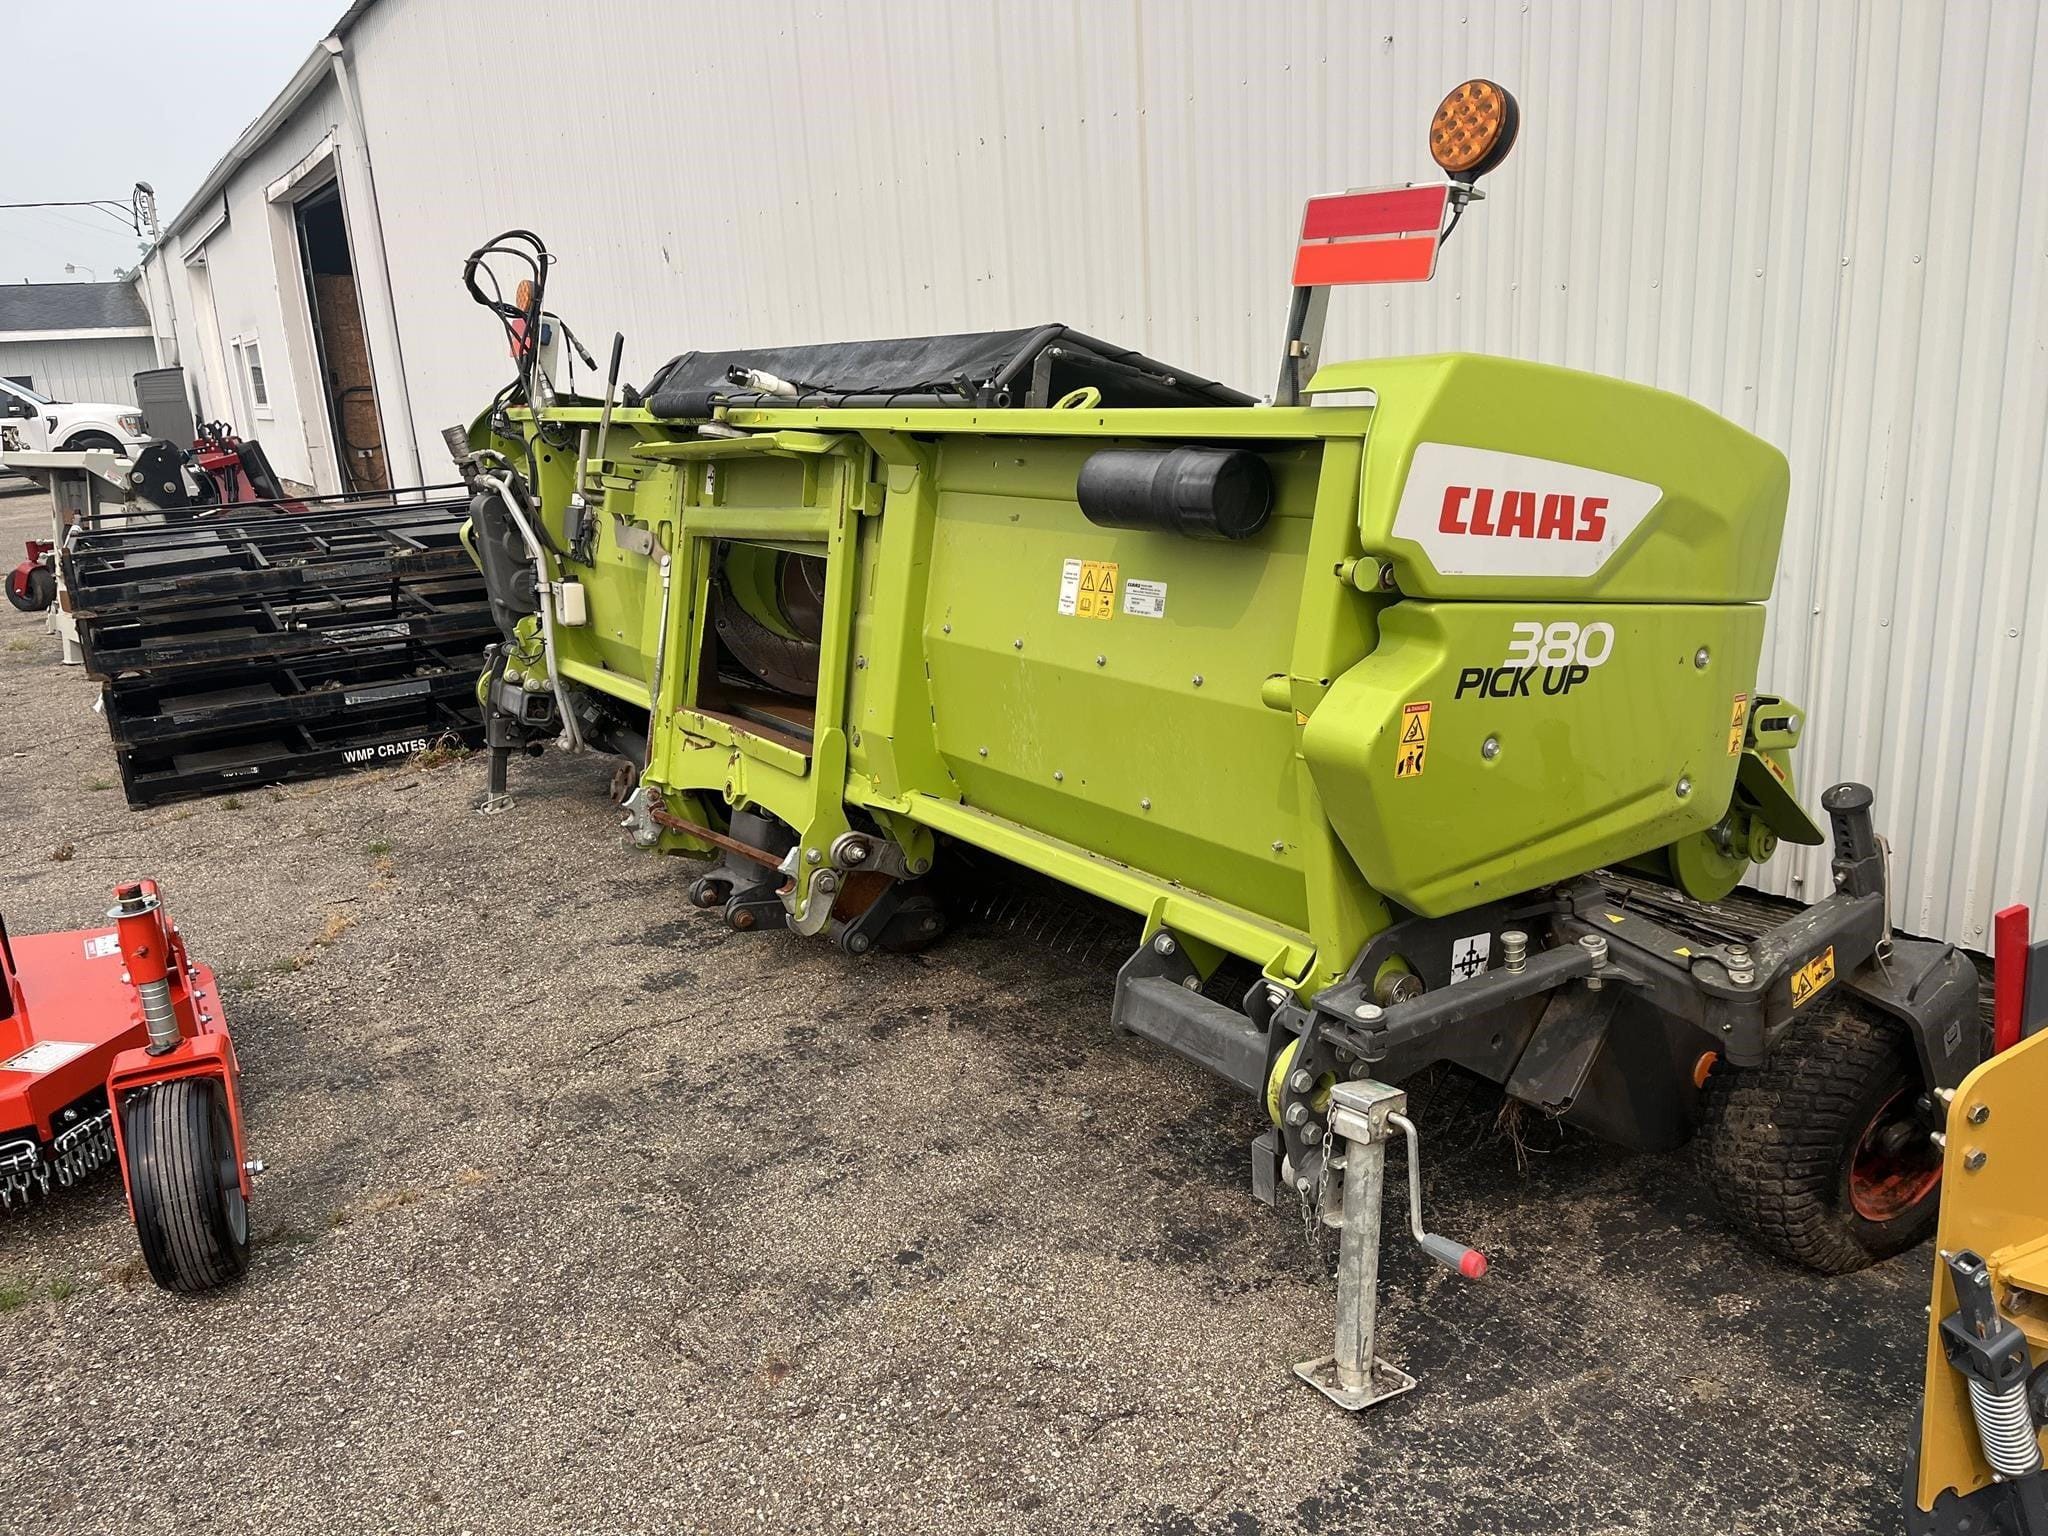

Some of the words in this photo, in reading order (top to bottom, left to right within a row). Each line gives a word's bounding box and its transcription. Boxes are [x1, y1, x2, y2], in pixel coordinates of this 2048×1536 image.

[1438, 485, 1609, 542] CLAAS
[1503, 621, 1615, 668] 380
[1455, 666, 1539, 700] PICK
[1542, 665, 1589, 695] UP
[344, 747, 375, 763] WMP
[377, 738, 427, 757] CRATES
